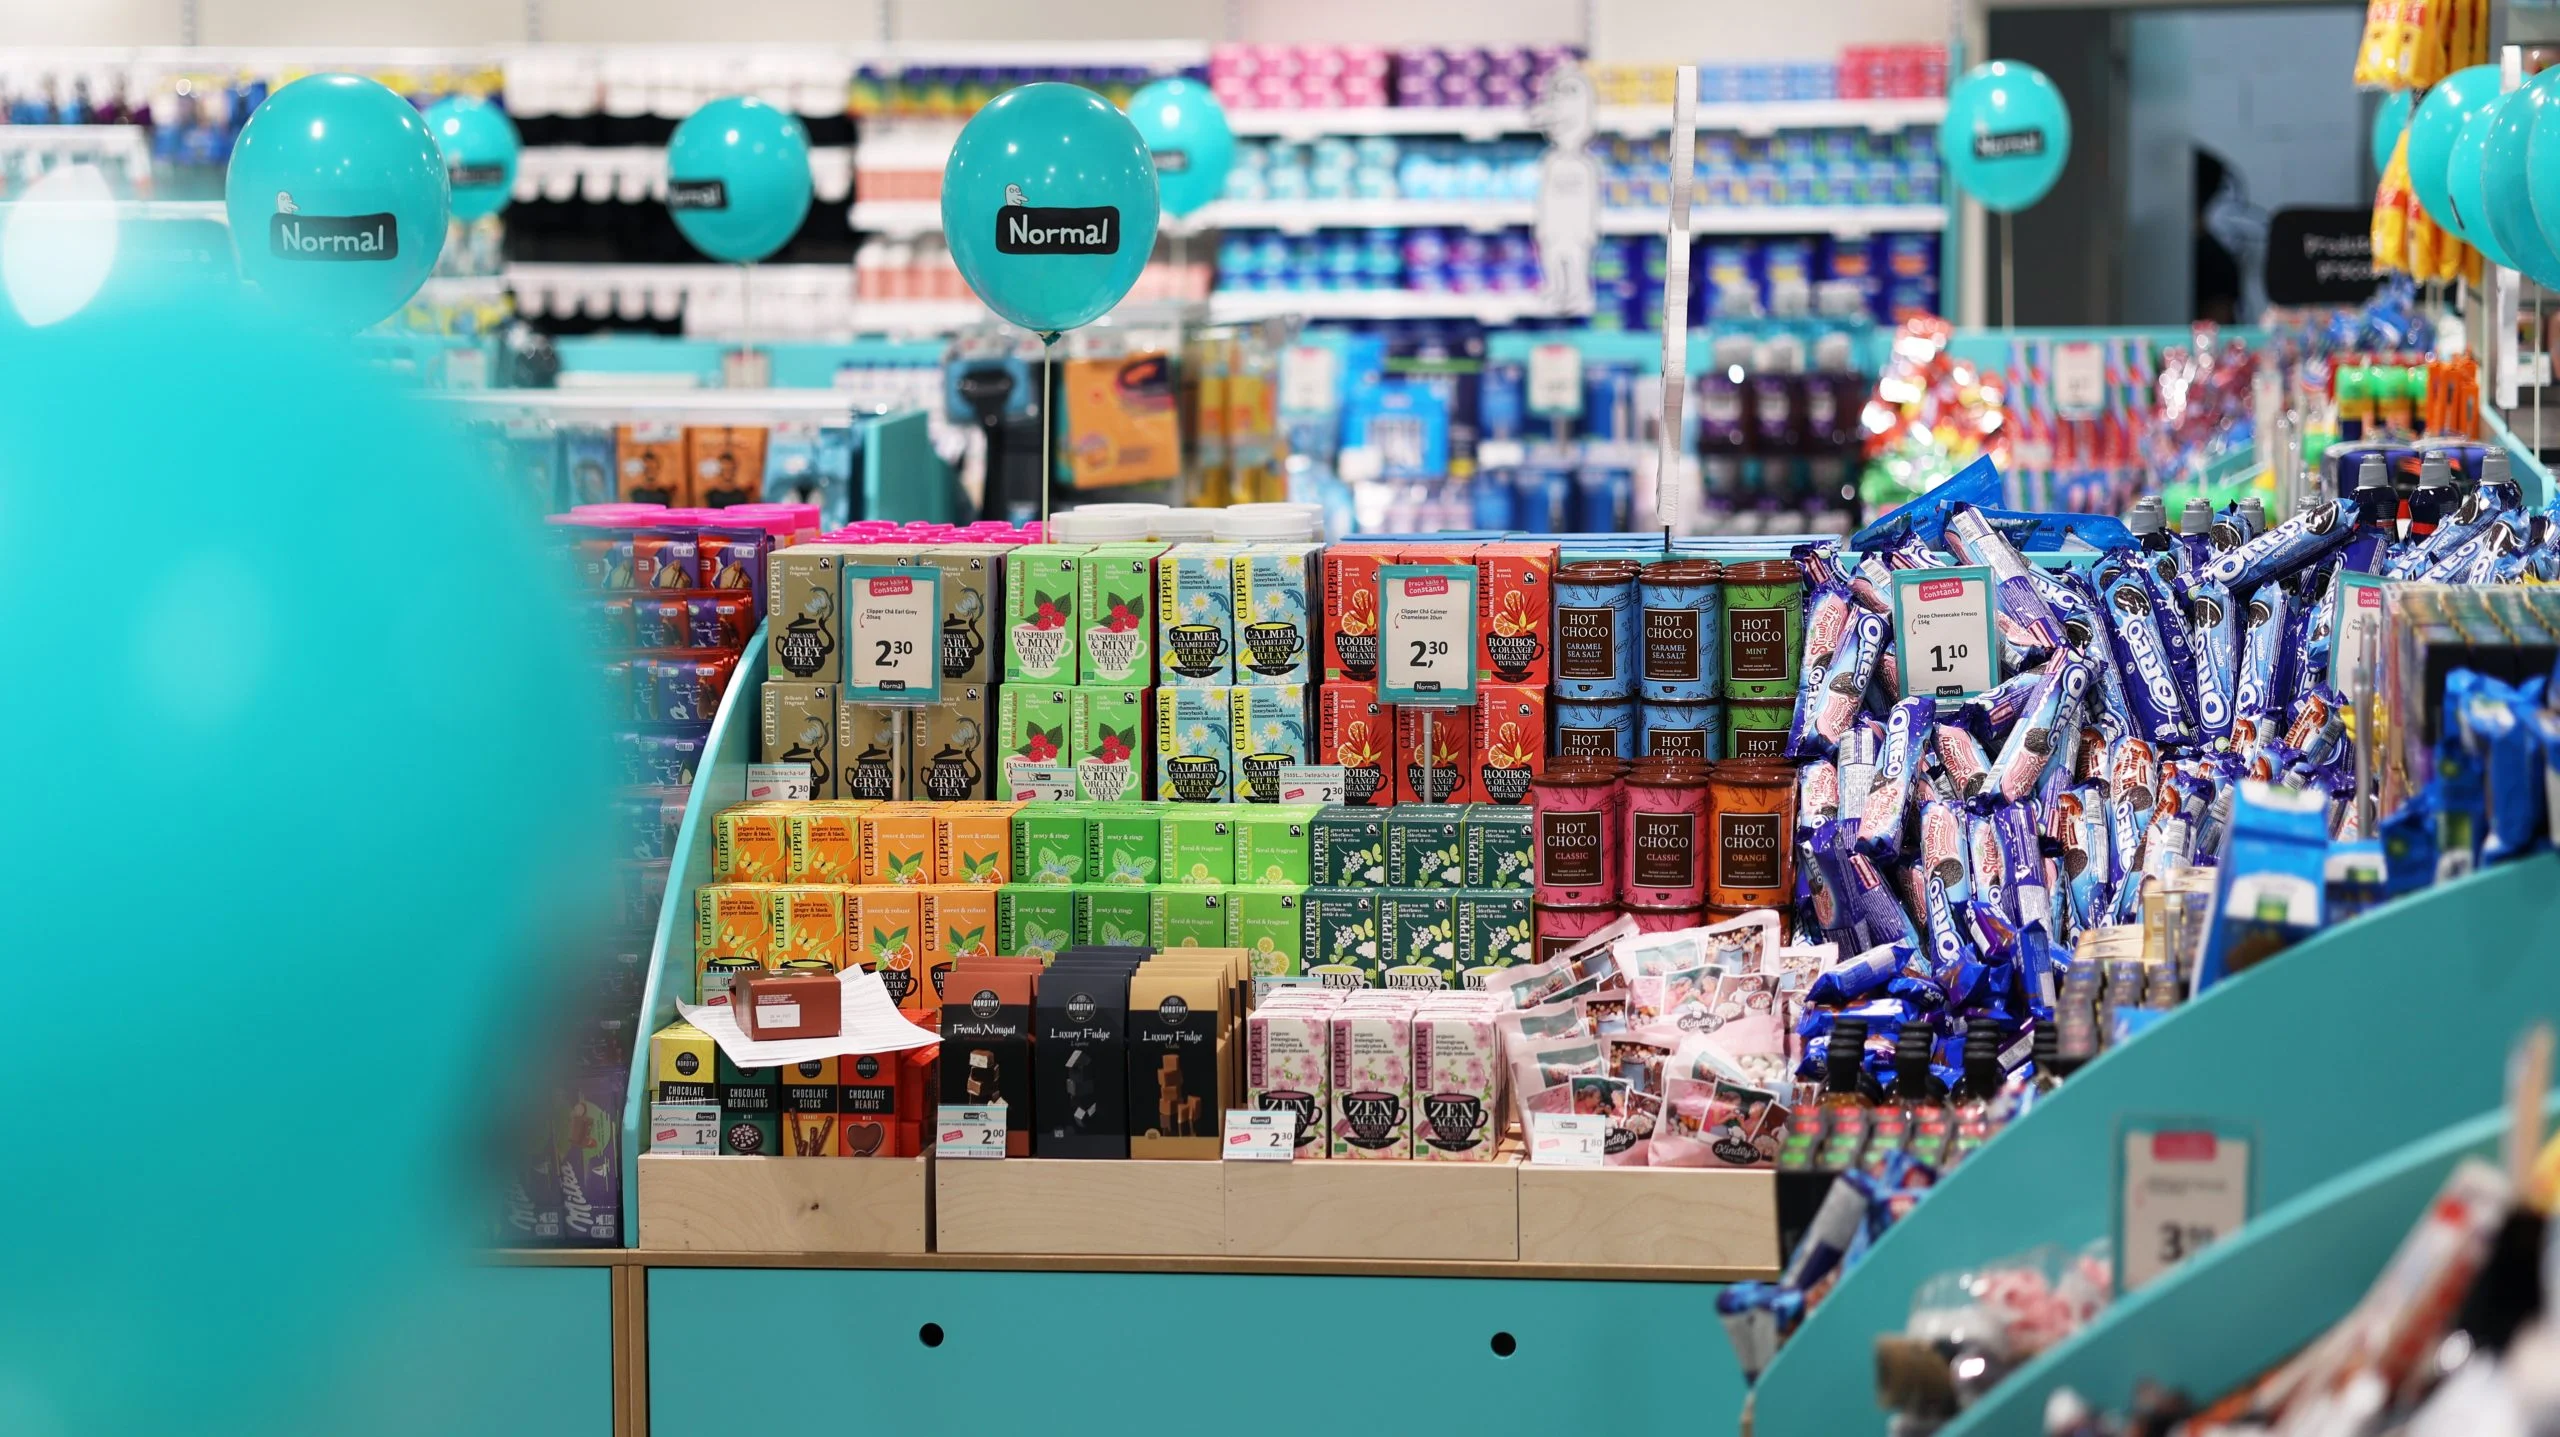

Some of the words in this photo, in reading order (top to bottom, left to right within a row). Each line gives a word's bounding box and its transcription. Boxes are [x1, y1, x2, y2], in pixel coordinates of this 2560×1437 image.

[1008, 214, 1108, 245] Normal
[281, 222, 385, 252] Normal
[2213, 519, 2302, 583] OREO
[2272, 537, 2302, 559] ORIGINAL
[771, 560, 781, 616] CLIPPER
[1010, 560, 1020, 617] CLIPPER
[1083, 563, 1094, 620] CLIPPER
[1162, 565, 1172, 621] CLIPPER
[1237, 562, 1247, 620] CLIPPER
[1328, 560, 1337, 617] CLIPPER
[1479, 561, 1489, 617] CLIPPER
[1569, 614, 1598, 625] HOT
[1654, 615, 1682, 626] HOT
[1741, 618, 1771, 630] HOT
[1013, 631, 1064, 640] RASPBERRY
[1246, 629, 1295, 639] CALMER
[1561, 626, 1609, 638] CHOCO
[1646, 628, 1693, 639] CHOCO
[1811, 604, 1839, 656] Strawberry
[1088, 634, 1138, 642] RASPBERRY
[1170, 631, 1220, 642] CALMER
[1248, 638, 1294, 646] CHAMELEON
[1488, 637, 1536, 647] ROOIBOS
[1733, 631, 1781, 642] CHOCO
[788, 638, 820, 648] EARL
[1027, 639, 1062, 650] MINT
[1101, 641, 1136, 652] MINT
[1172, 640, 1218, 648] CHAMELEON
[1566, 642, 1603, 650] CARAMEL
[1651, 644, 1687, 652] CARAMEL
[783, 647, 823, 658] GREY
[875, 640, 913, 667] 2,30
[1409, 640, 1448, 667] 2,30
[1498, 646, 1533, 654] ORANGE
[1567, 650, 1581, 658] SEA
[1582, 650, 1601, 658] SALT
[1746, 647, 1768, 655] MINT
[1854, 614, 1883, 691] OREO
[2211, 636, 2224, 668] ORIGINAL
[791, 657, 815, 666] TEA
[1023, 654, 1055, 662] GREEN
[1098, 657, 1130, 665] GREEN
[1180, 654, 1212, 662] RELAX
[1257, 652, 1288, 660] RELAX
[1493, 653, 1532, 661] ORGANIC
[1666, 652, 1686, 660] SALT
[1930, 644, 1968, 672] 1,10
[1031, 661, 1049, 669] TEA
[1106, 663, 1124, 671] TEA
[2127, 620, 2179, 708] OREO
[882, 681, 903, 690] Normal
[1416, 682, 1438, 690] Normal
[2047, 664, 2088, 748] OREO
[765, 690, 775, 746] CLIPPER
[1002, 692, 1013, 748] CLIPPER
[1161, 695, 1171, 752] CLIPPER
[1235, 694, 1245, 751] CLIPPER
[1323, 691, 1333, 749] CLIPPER
[1571, 734, 1601, 746] HOT
[1661, 736, 1691, 748] HOT
[1884, 706, 1909, 778] OREO
[1748, 740, 1778, 752] HOT
[1079, 765, 1129, 773] RASPBERRY
[1169, 762, 1218, 773] CALMER
[933, 769, 965, 778] EARL
[1093, 772, 1127, 782] MINT
[1171, 771, 1216, 780] CHAMELEON
[1483, 769, 1531, 779] ROOIBOS
[928, 778, 969, 788] GREY
[1493, 778, 1528, 786] ORANGE
[937, 788, 961, 797] TEA
[1089, 788, 1121, 796] GREEN
[1178, 785, 1210, 793] RELAX
[1488, 785, 1526, 793] ORGANIC
[1556, 823, 1586, 834] HOT
[1648, 824, 1679, 835] HOT
[1734, 824, 1765, 836] HOT
[718, 820, 728, 872] CLIPPER
[792, 820, 802, 872] CLIPPER
[1547, 835, 1597, 848] CHOCO
[1638, 837, 1688, 849] CHOCO
[1724, 837, 1775, 849] CHOCO
[1925, 813, 1942, 871] Strawberry
[864, 822, 874, 877] CLIPPER
[1015, 822, 1026, 876] CLIPPER
[1164, 824, 1173, 879] CLIPPER
[1314, 827, 1324, 884] CLIPPER
[1391, 827, 1400, 884] CLIPPER
[1468, 827, 1478, 885] CLIPPER
[1555, 852, 1589, 860] CLASSIC
[1646, 854, 1680, 862] CLASSIC
[1731, 854, 1767, 862] ORANGE
[1804, 847, 1823, 883] OREO
[702, 894, 712, 946] CLIPPER
[1930, 879, 1961, 962] OREO
[1388, 974, 1439, 987] DETOX
[1679, 1015, 1722, 1030] Kindly's
[953, 1024, 983, 1035] French
[981, 1024, 1015, 1037] Nougat
[1050, 1028, 1081, 1041] Luxury
[1083, 1029, 1111, 1040] Fudge
[1142, 1031, 1174, 1043] Luxury
[1175, 1031, 1203, 1042] Fudge
[1252, 1026, 1262, 1086] CLIPPER
[1417, 1028, 1427, 1089] CLIPPER
[668, 1086, 704, 1096] CHOCOLATE
[730, 1088, 766, 1098] CHOCOLATE
[792, 1089, 828, 1099] CHOCOLATE
[849, 1089, 885, 1099] CHOCOLATE
[727, 1098, 769, 1108] MEDALLIONS
[799, 1099, 821, 1109] STICKS
[854, 1099, 880, 1110] HEARTS
[1348, 1101, 1393, 1116] ZEN
[1430, 1102, 1474, 1118] ZEN
[1352, 1115, 1391, 1125] AGAIN
[1434, 1117, 1473, 1128] AGAIN
[560, 1160, 594, 1233] Milka
